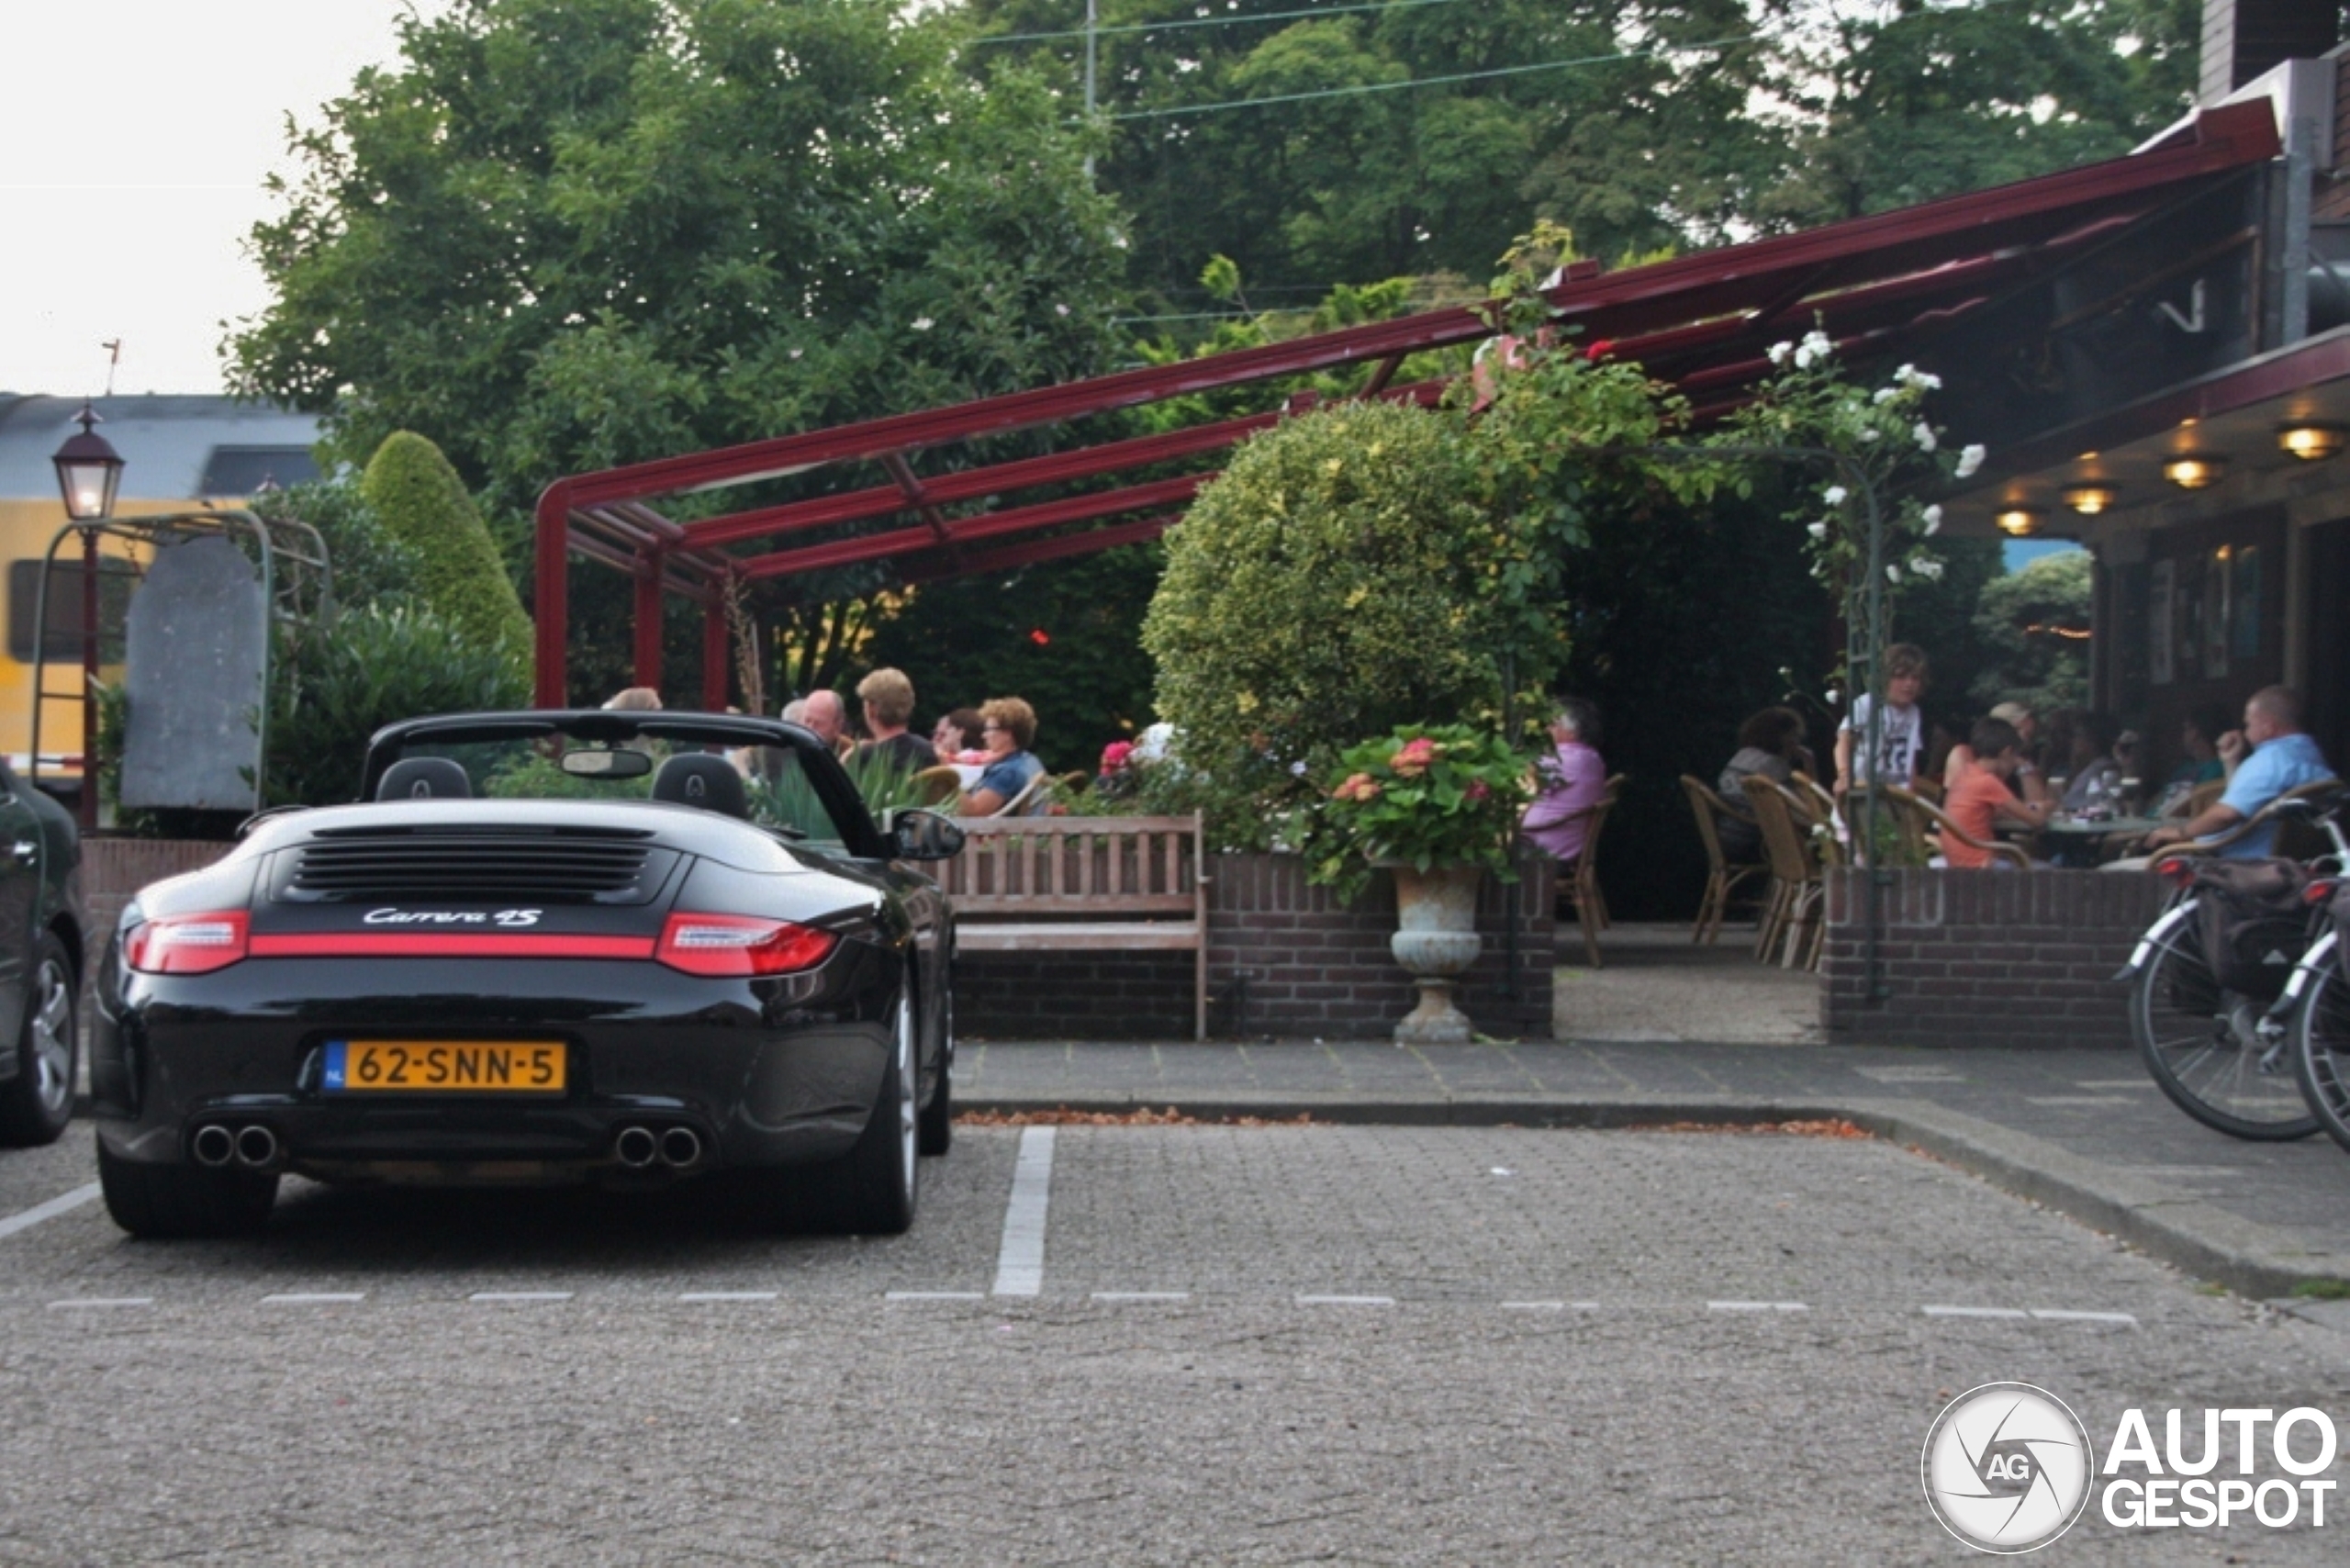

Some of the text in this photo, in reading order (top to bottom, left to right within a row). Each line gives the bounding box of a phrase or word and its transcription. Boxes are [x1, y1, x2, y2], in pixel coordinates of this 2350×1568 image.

[364, 907, 543, 926] Carrera 4S
[357, 1047, 554, 1084] 62-SNN-5
[327, 1070, 344, 1081] NL
